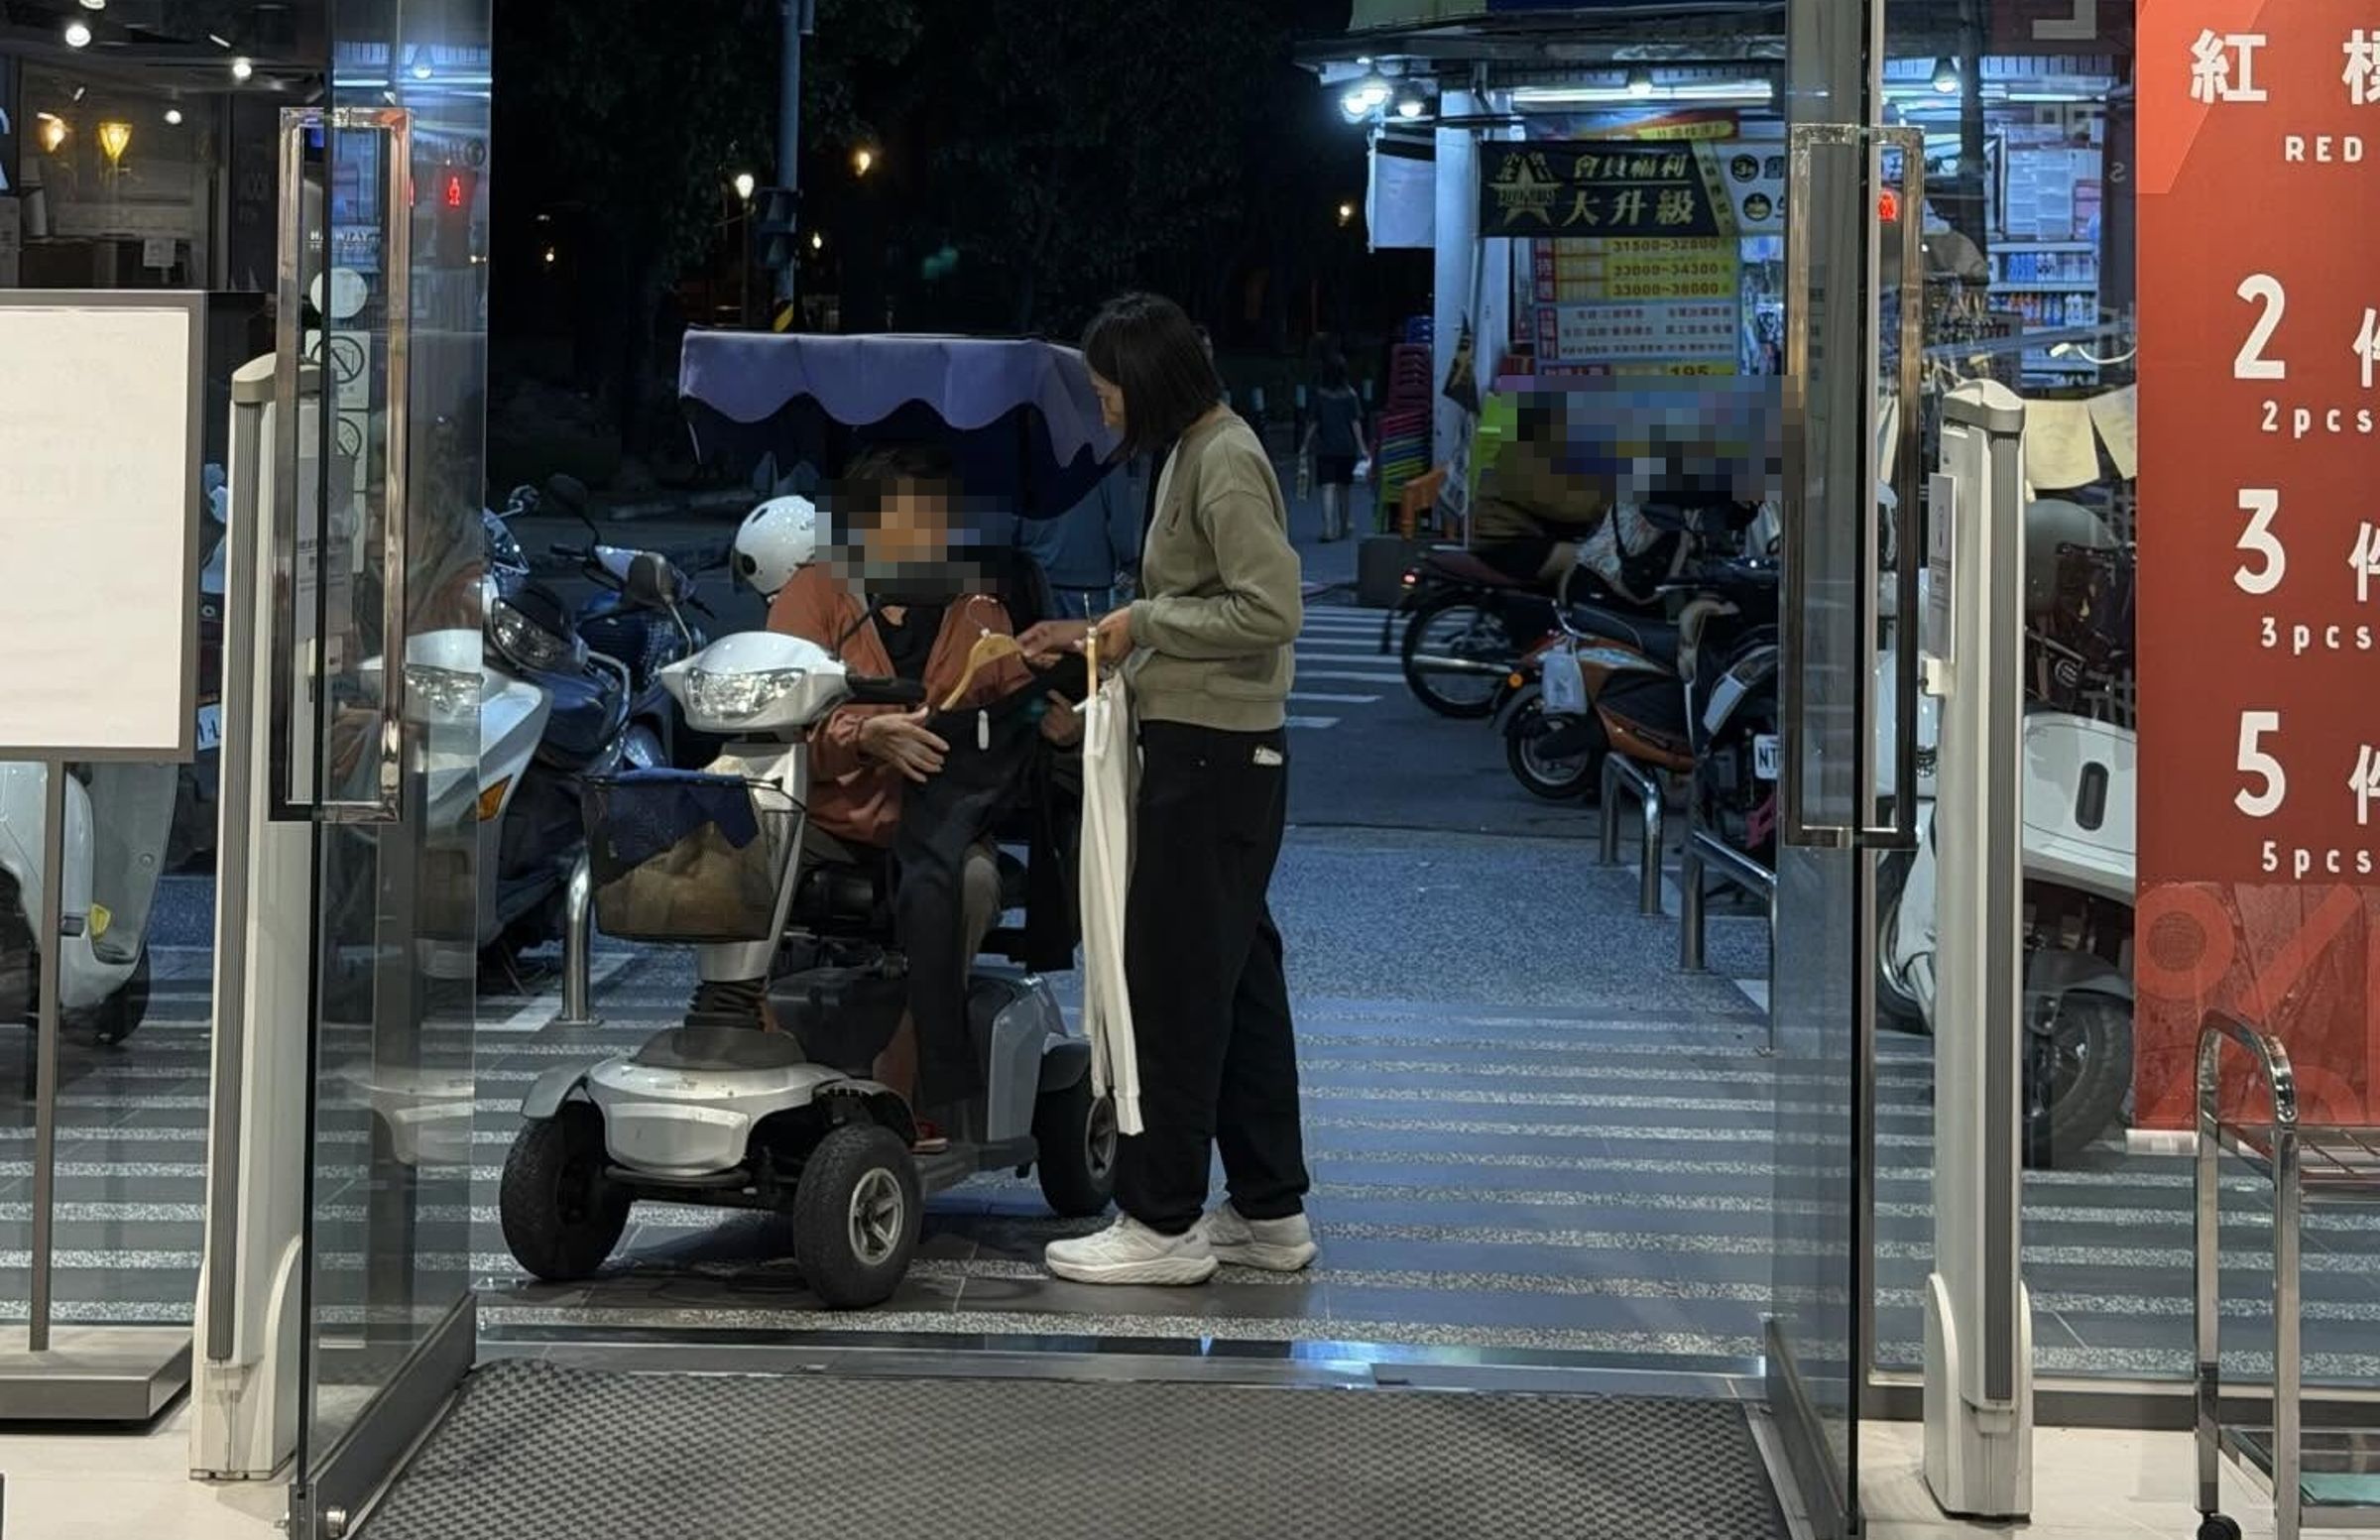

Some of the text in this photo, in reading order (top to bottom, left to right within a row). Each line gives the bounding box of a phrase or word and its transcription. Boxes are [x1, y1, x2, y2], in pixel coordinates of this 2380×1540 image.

[2285, 136, 2363, 162] RED
[1561, 189, 1696, 226] 大升級
[2234, 274, 2285, 379] 2
[2262, 401, 2373, 438] 2pcs
[2234, 489, 2286, 594] 3
[2262, 617, 2372, 654] 3pcs
[2234, 711, 2286, 817] 5
[2262, 841, 2372, 879] 5pcs
